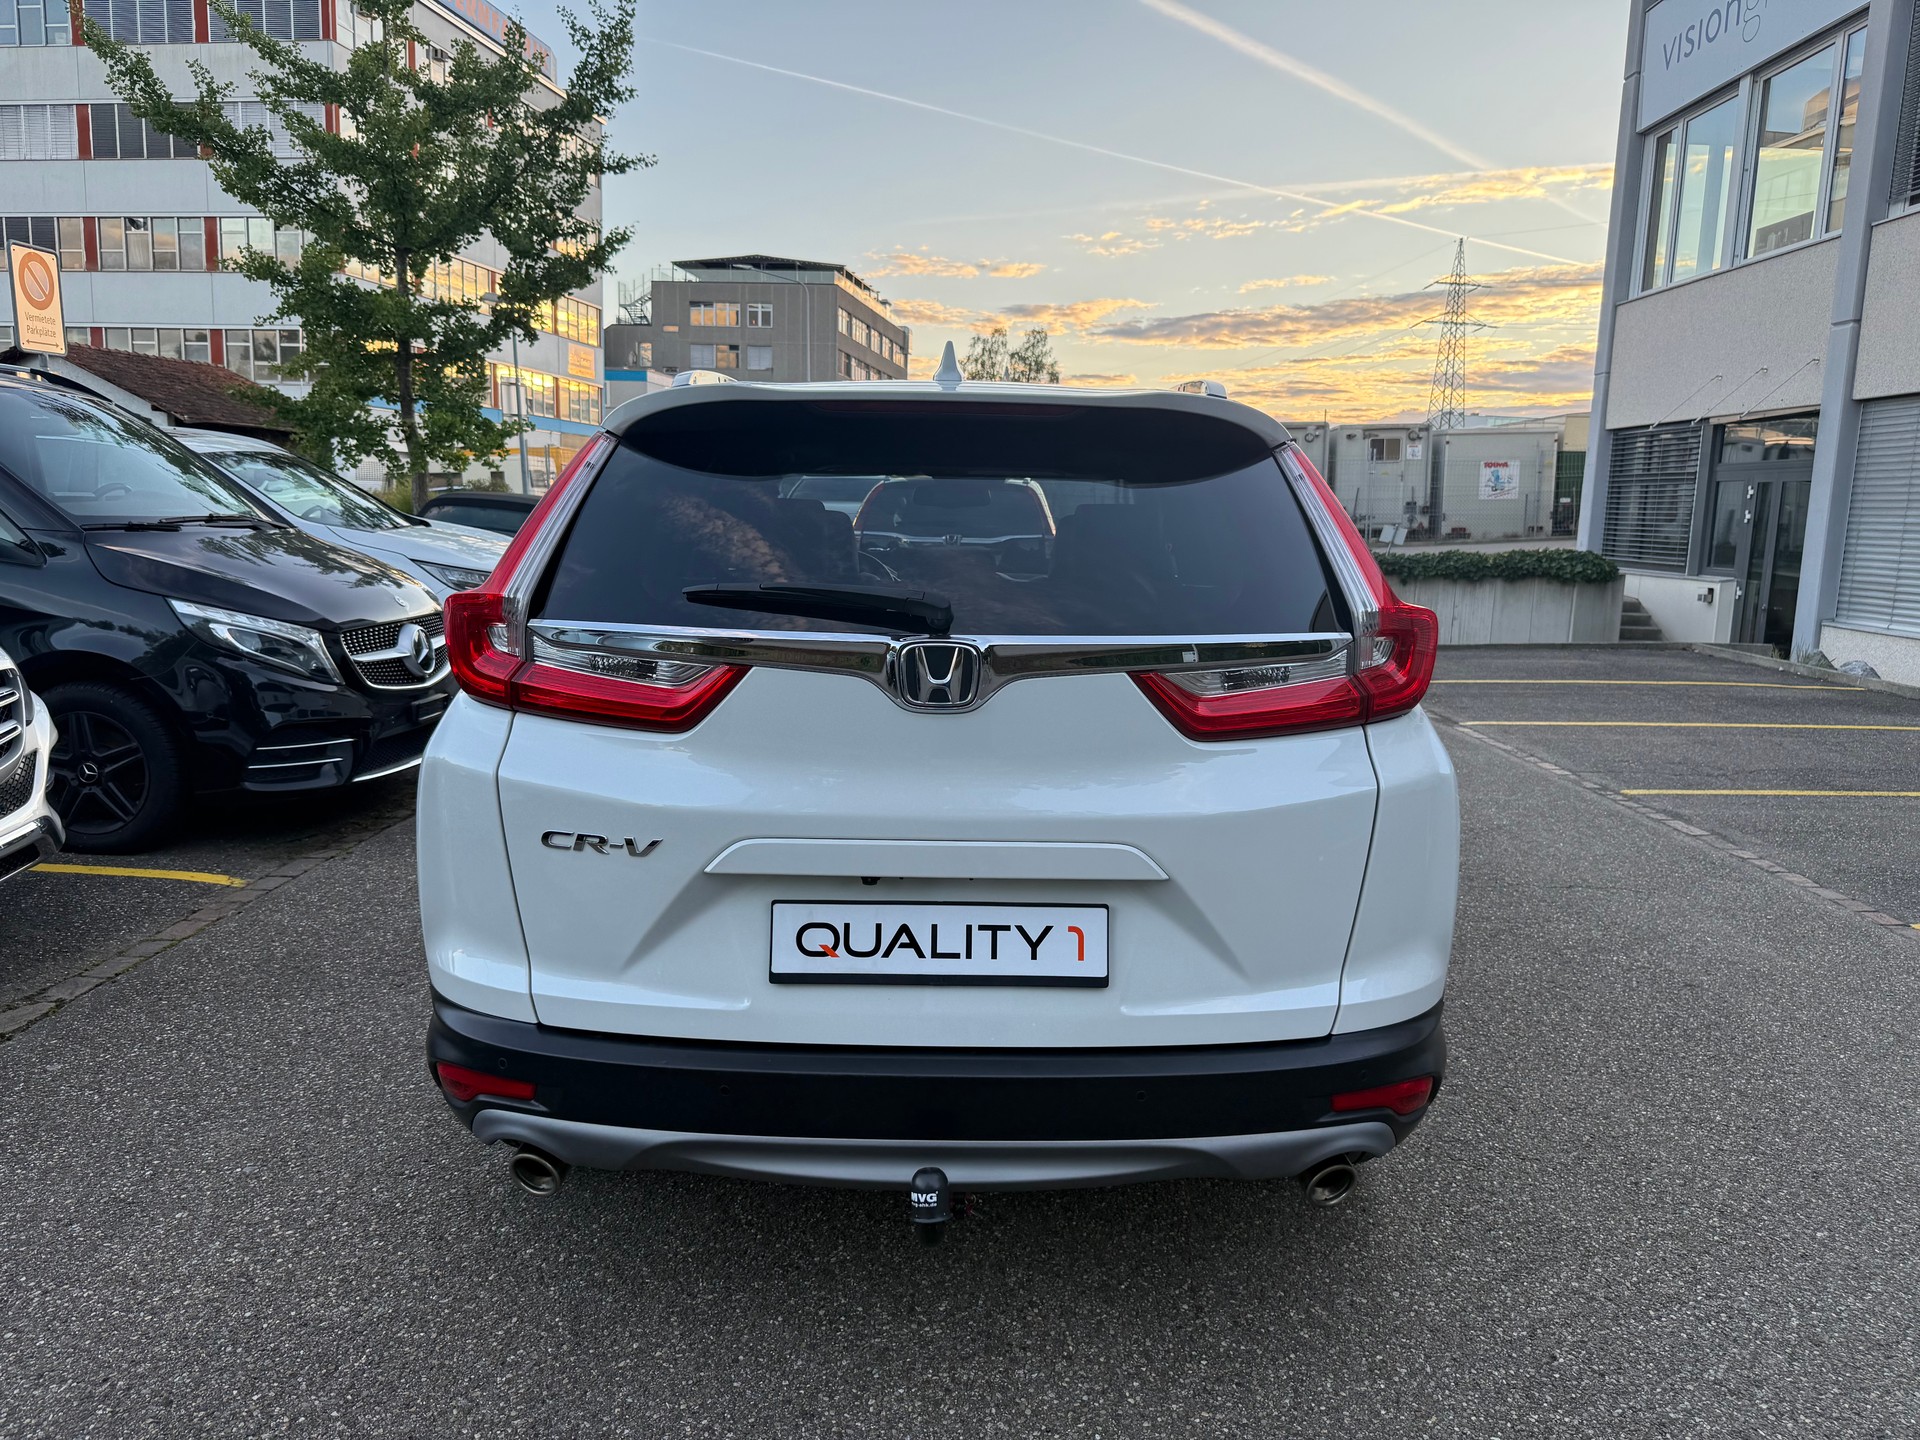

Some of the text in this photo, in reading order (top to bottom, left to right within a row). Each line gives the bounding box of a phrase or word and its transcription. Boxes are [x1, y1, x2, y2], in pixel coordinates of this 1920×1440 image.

[25, 311, 57, 326] Vermietete
[26, 324, 57, 338] Parkplätze
[541, 829, 663, 857] CR-V
[796, 922, 1085, 961] QUALITY 1
